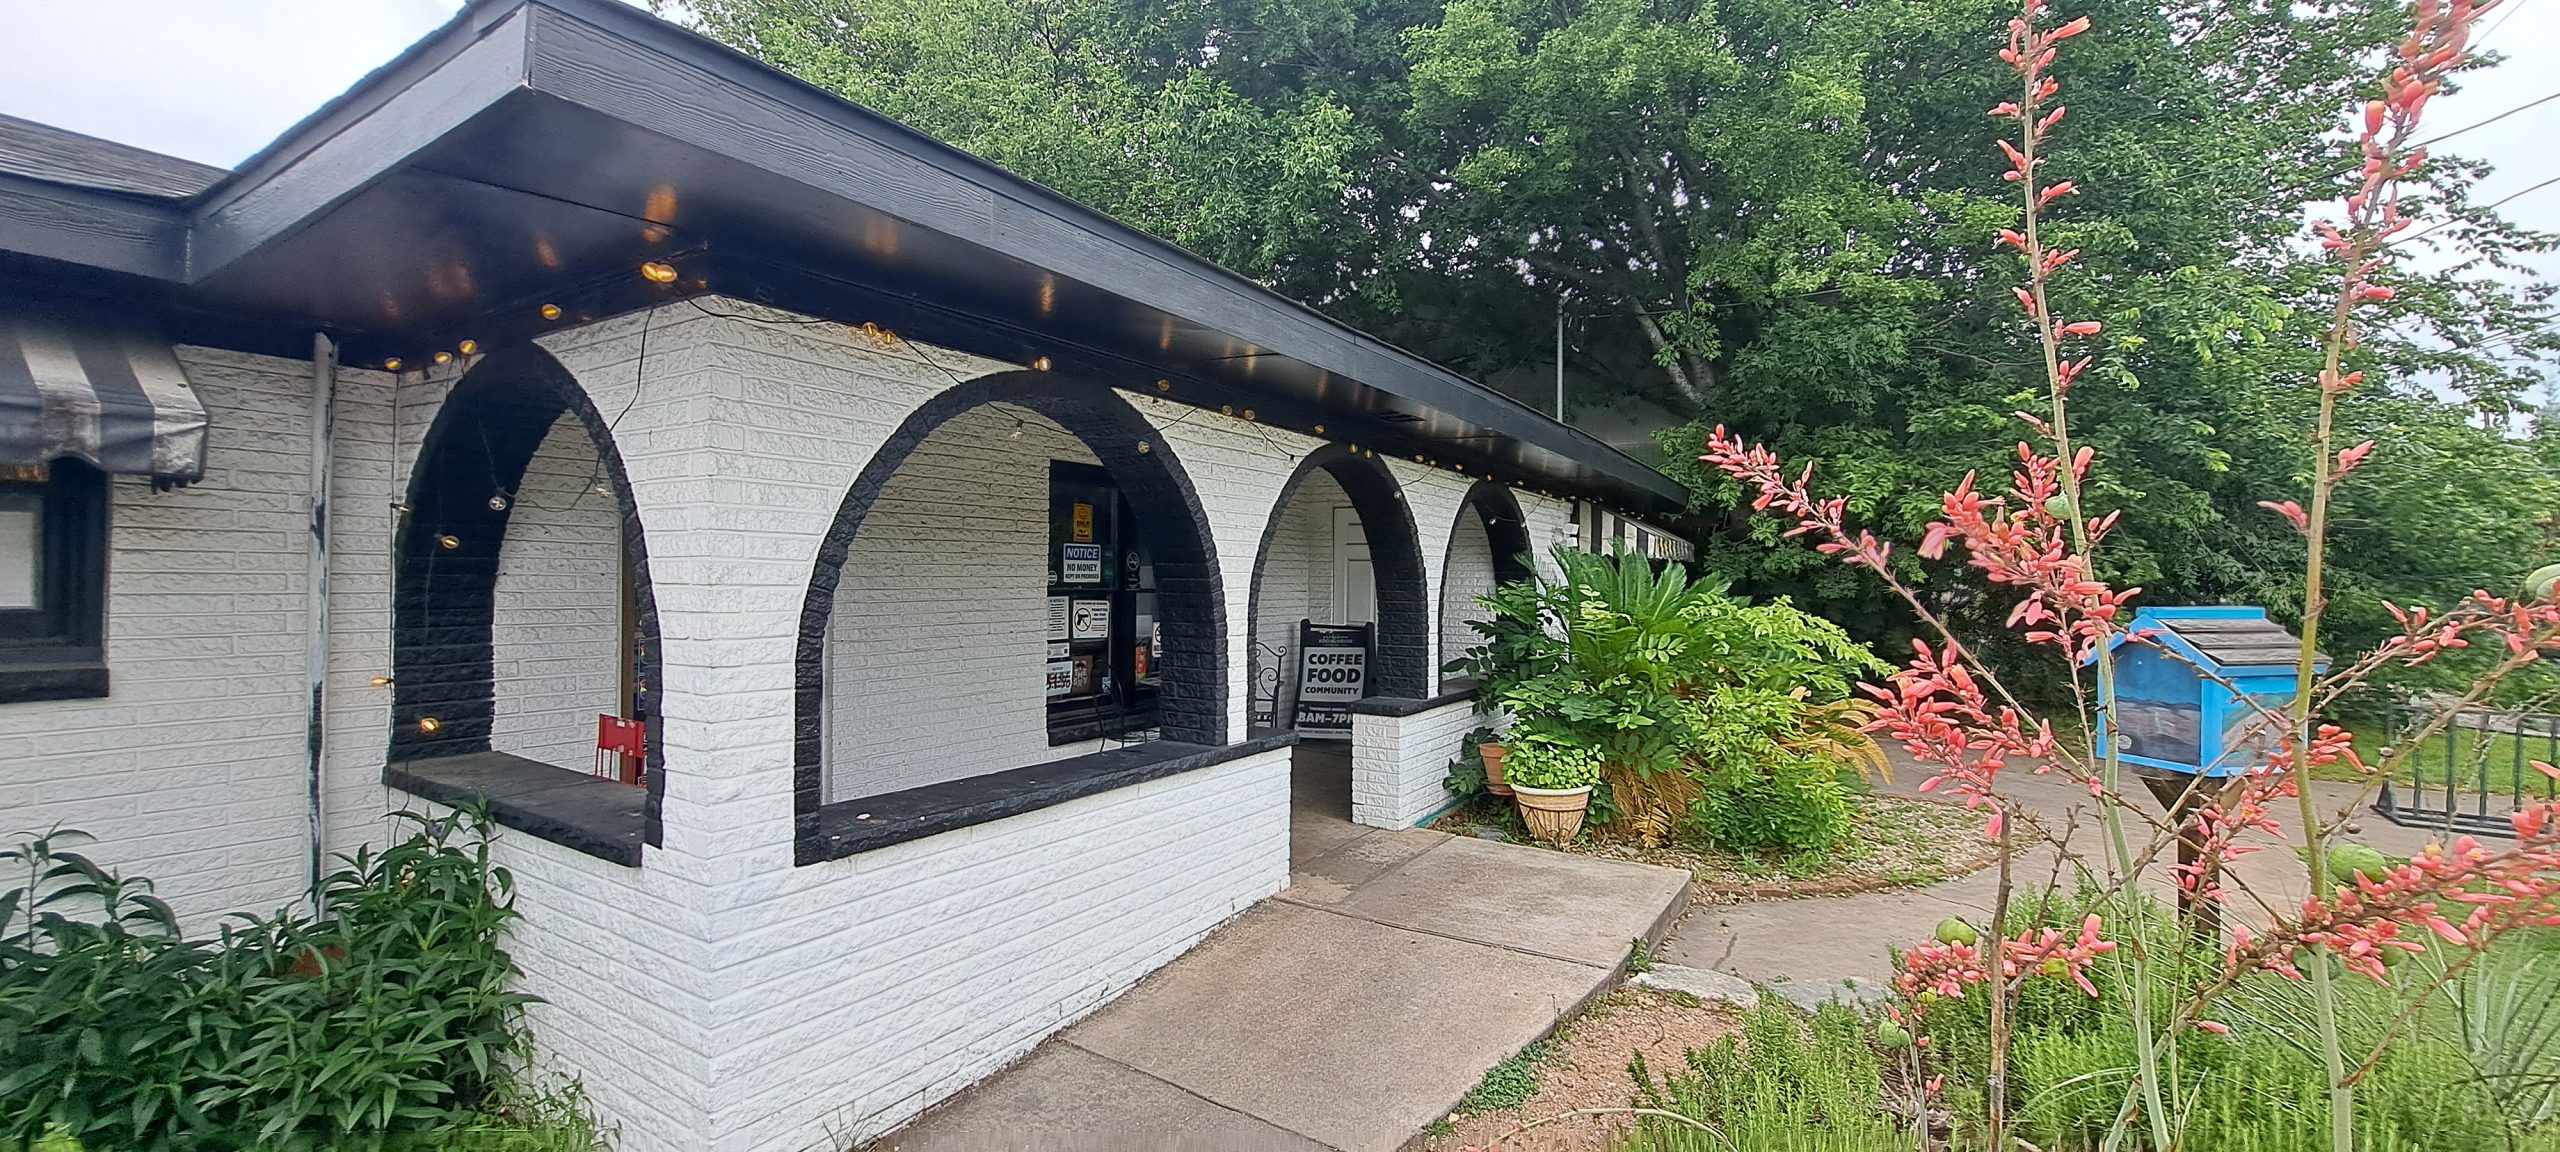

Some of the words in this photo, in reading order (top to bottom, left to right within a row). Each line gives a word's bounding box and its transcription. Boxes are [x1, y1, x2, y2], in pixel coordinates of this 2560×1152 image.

[1066, 547, 1099, 559] NOTICE
[1067, 563, 1076, 572] NO
[1077, 563, 1098, 572] MONEY
[1308, 653, 1363, 665] COFFEE
[1306, 668, 1361, 683] FOOD
[1305, 686, 1359, 695] COMMUNITY
